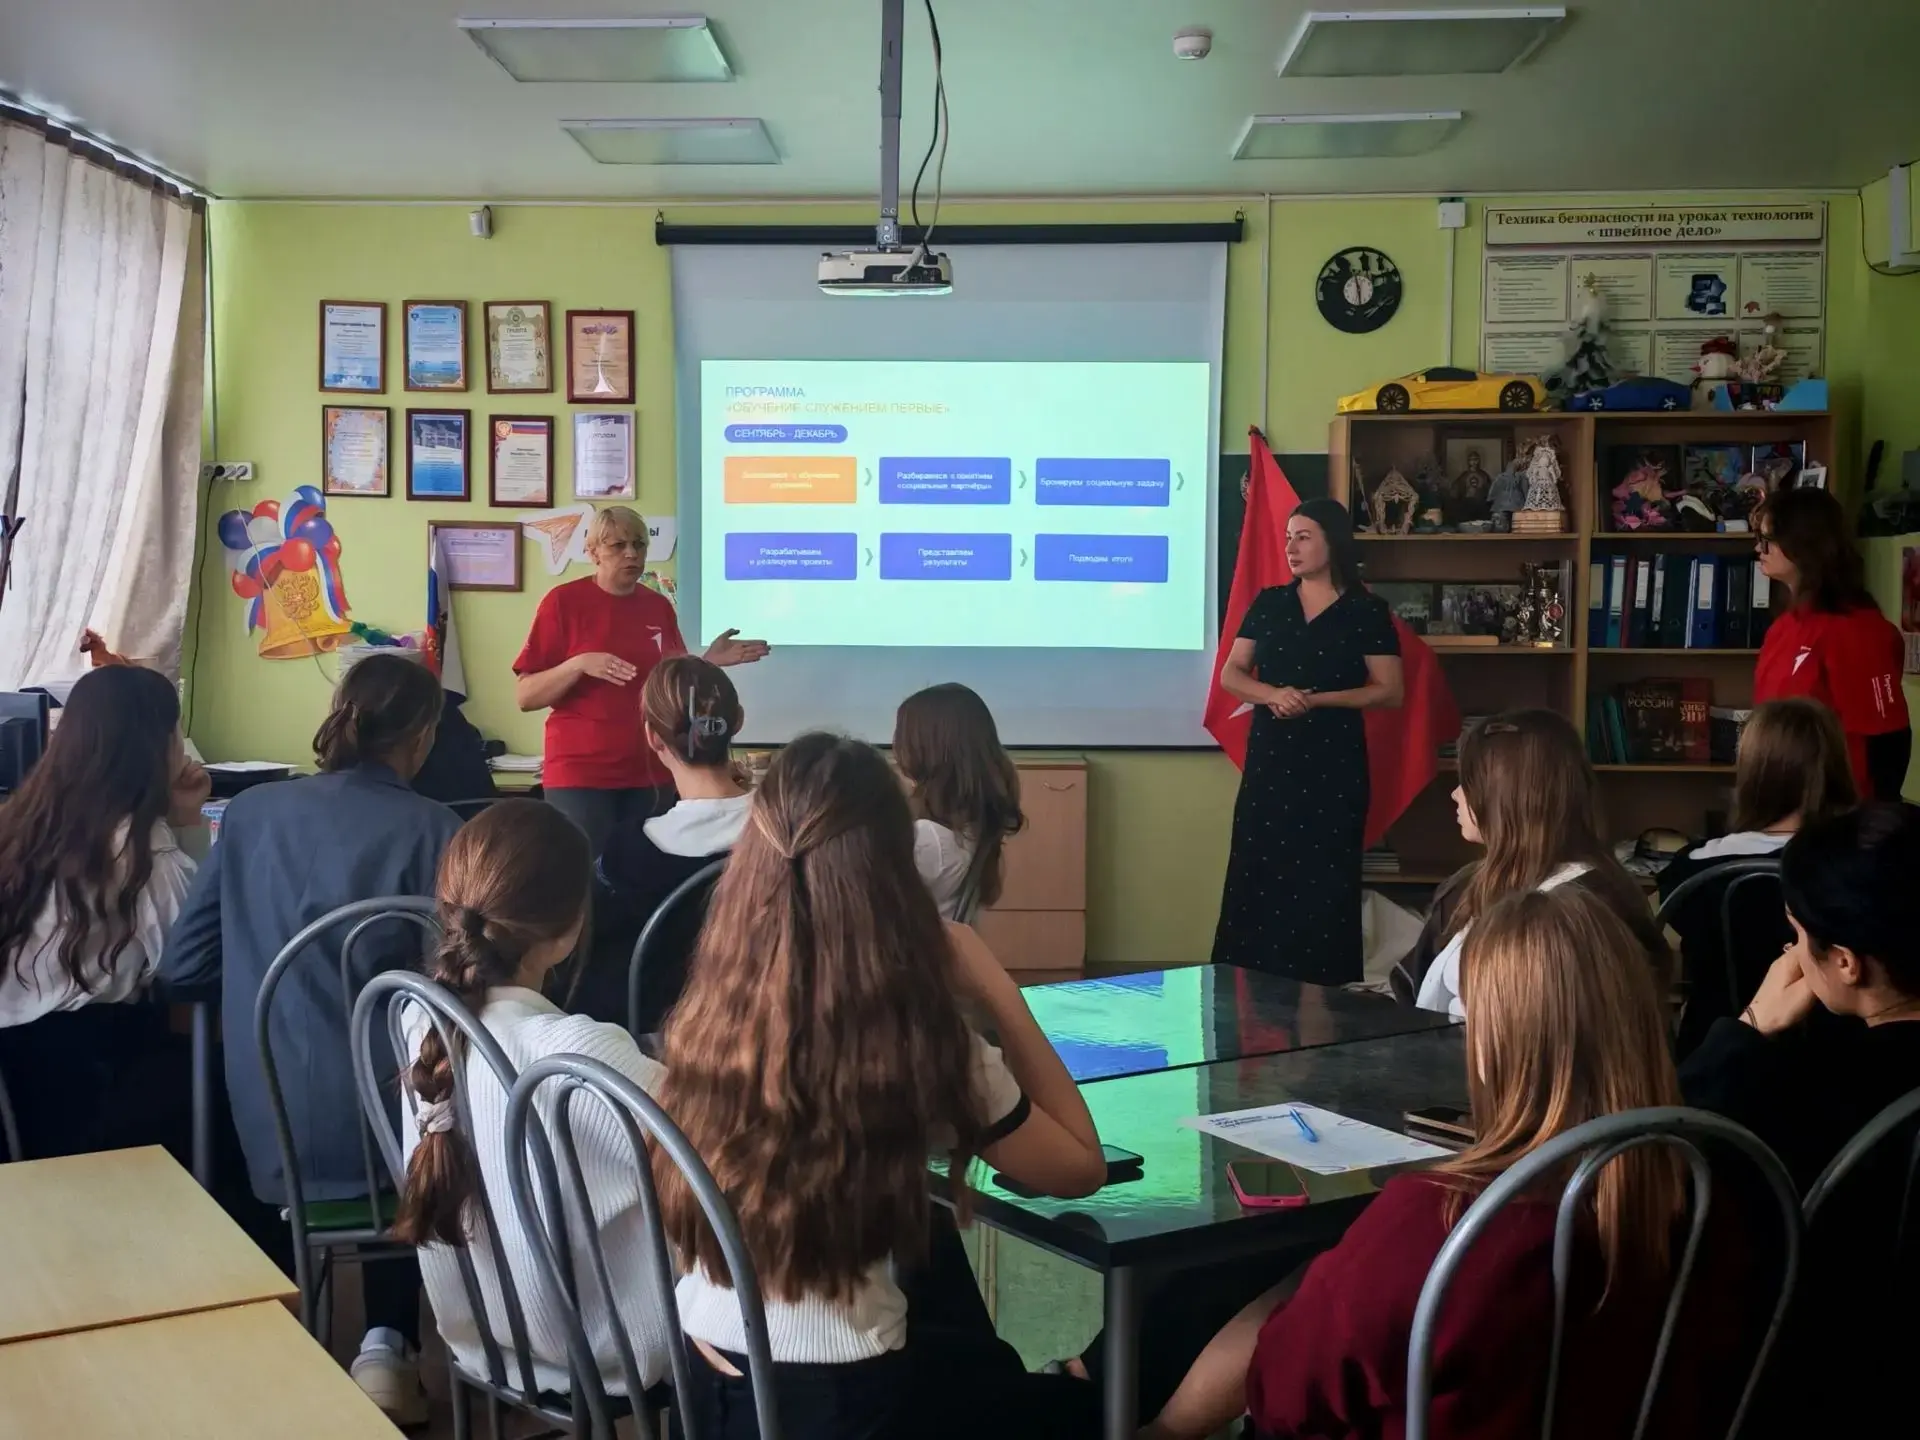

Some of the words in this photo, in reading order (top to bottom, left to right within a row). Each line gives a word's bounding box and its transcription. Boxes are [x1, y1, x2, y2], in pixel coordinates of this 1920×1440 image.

[1496, 213, 1555, 225] Техника
[1558, 211, 1656, 225] безопасности
[1659, 213, 1675, 222] на
[1678, 212, 1728, 224] уроках
[1731, 211, 1814, 221] технологии
[1599, 225, 1672, 238] швейное
[1676, 226, 1722, 238] дело»
[725, 387, 805, 398] ПРОГРАММА
[726, 402, 800, 414] «ОБУЧЕНИЕ
[805, 403, 887, 414] СЛУЖЕНИЕМ
[890, 403, 950, 414] ПЕРВЫЕ»
[734, 428, 786, 438] СЕНТЯБРЬ
[793, 428, 838, 439] ДЕКАБРЬ
[1040, 478, 1083, 487] Бронируем
[1086, 480, 1134, 489] социальную
[1136, 480, 1165, 489] задачу
